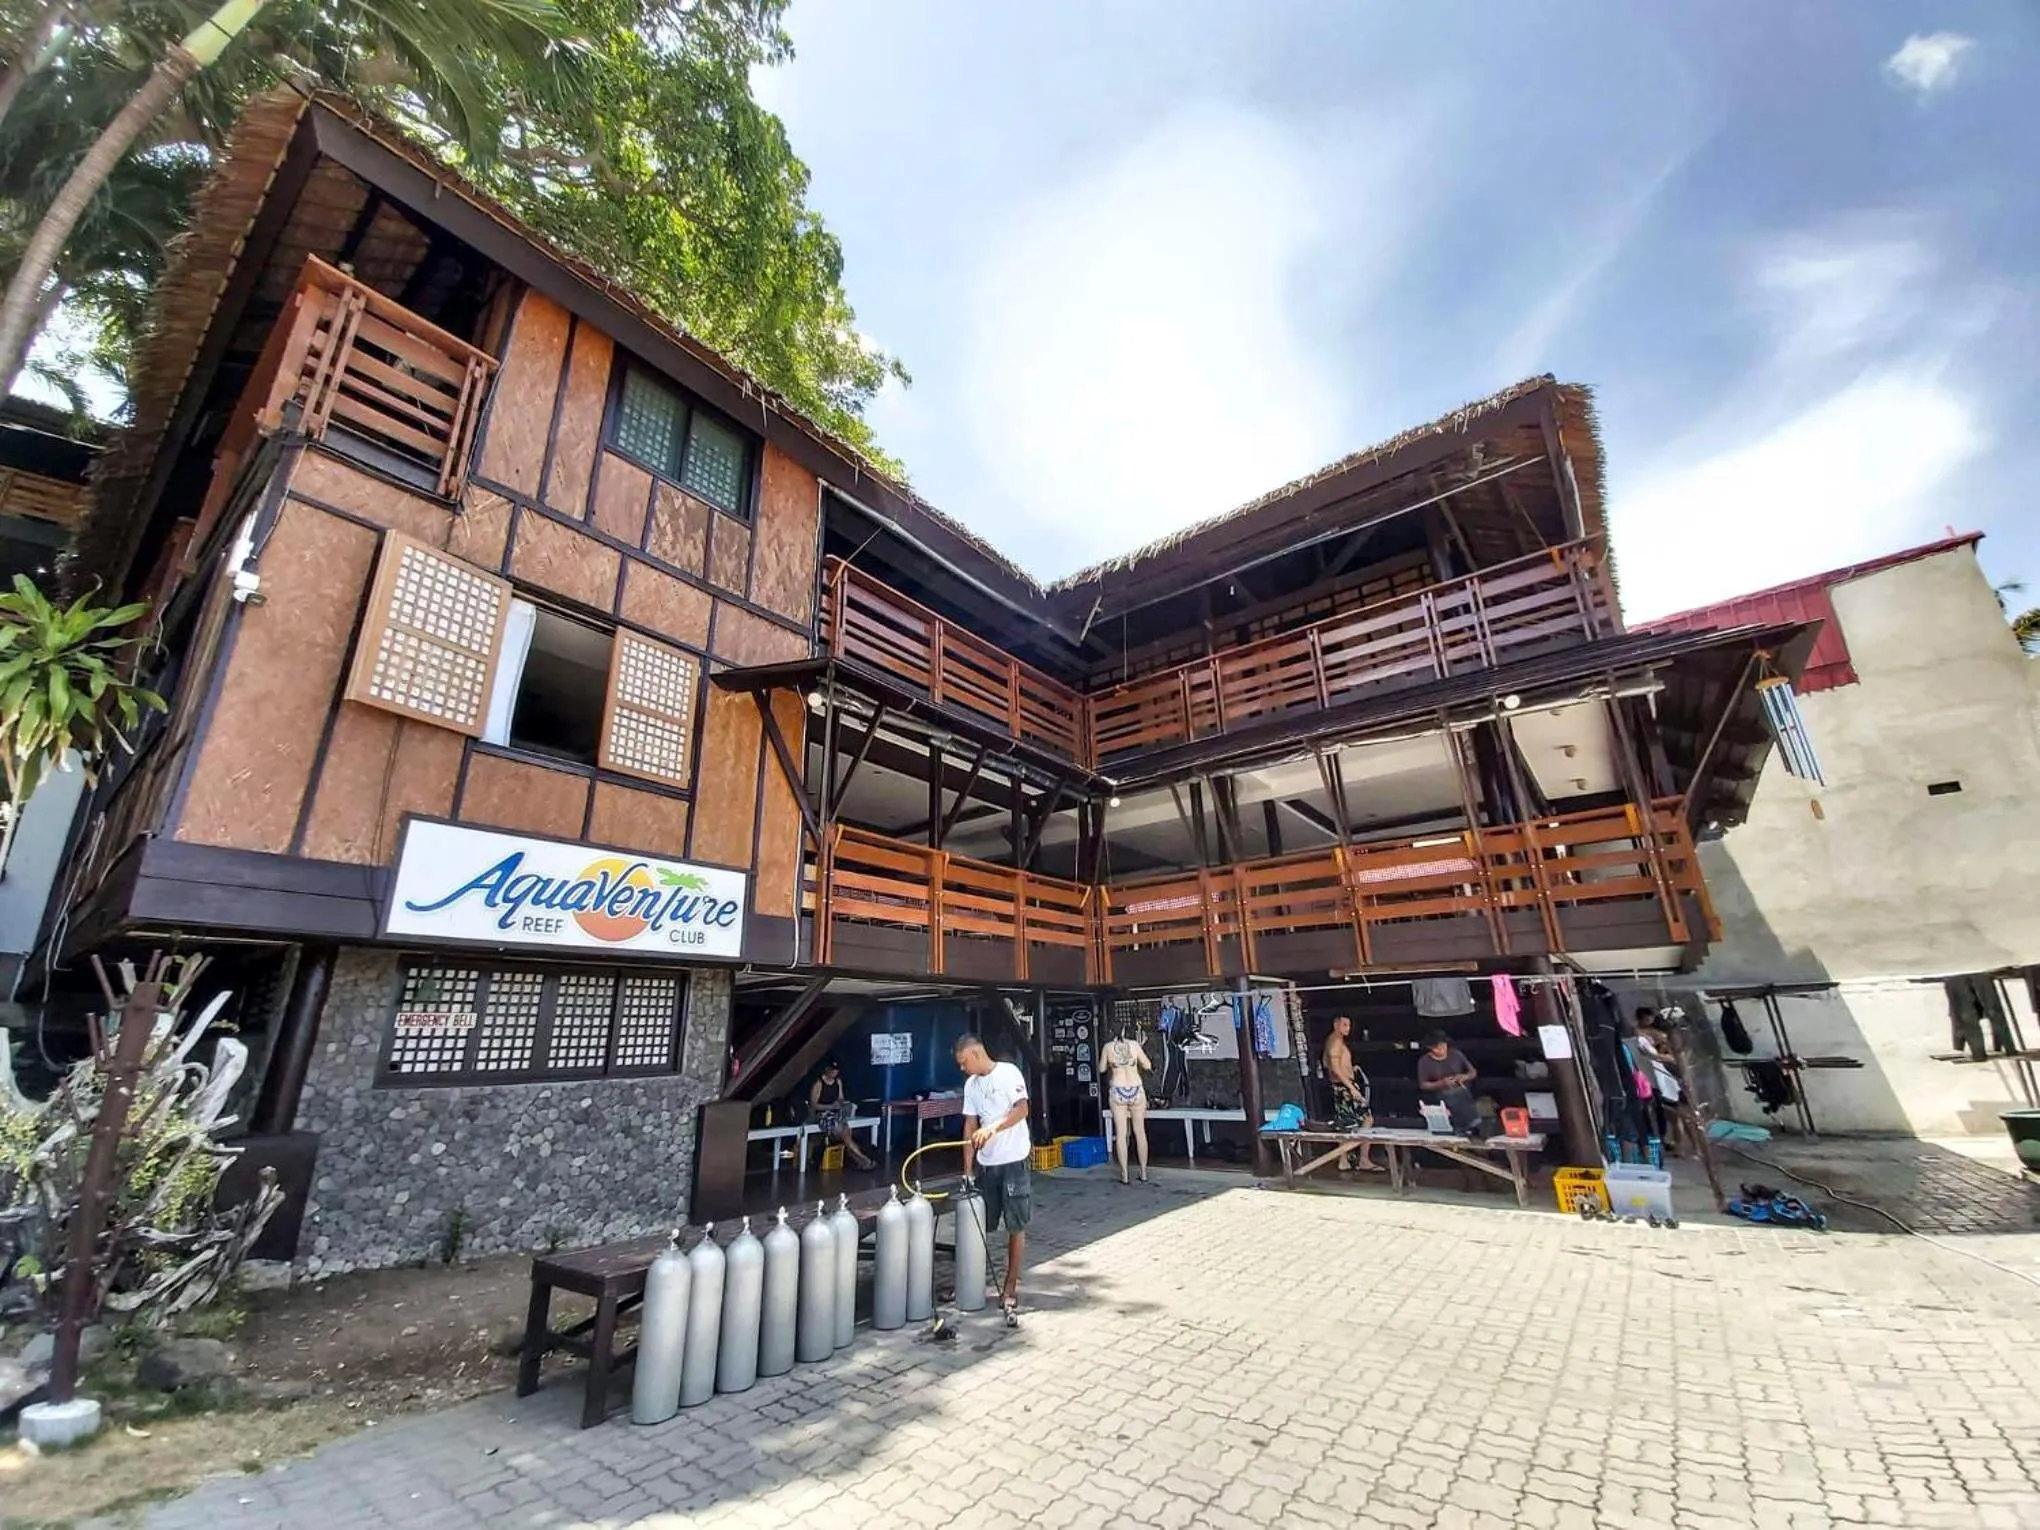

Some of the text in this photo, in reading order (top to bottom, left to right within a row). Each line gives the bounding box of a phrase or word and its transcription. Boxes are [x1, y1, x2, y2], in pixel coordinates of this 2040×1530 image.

[405, 851, 738, 929] AquaVenture
[522, 916, 705, 945] REEF CLUB
[398, 1014, 473, 1027] EMERGENCY BELL
